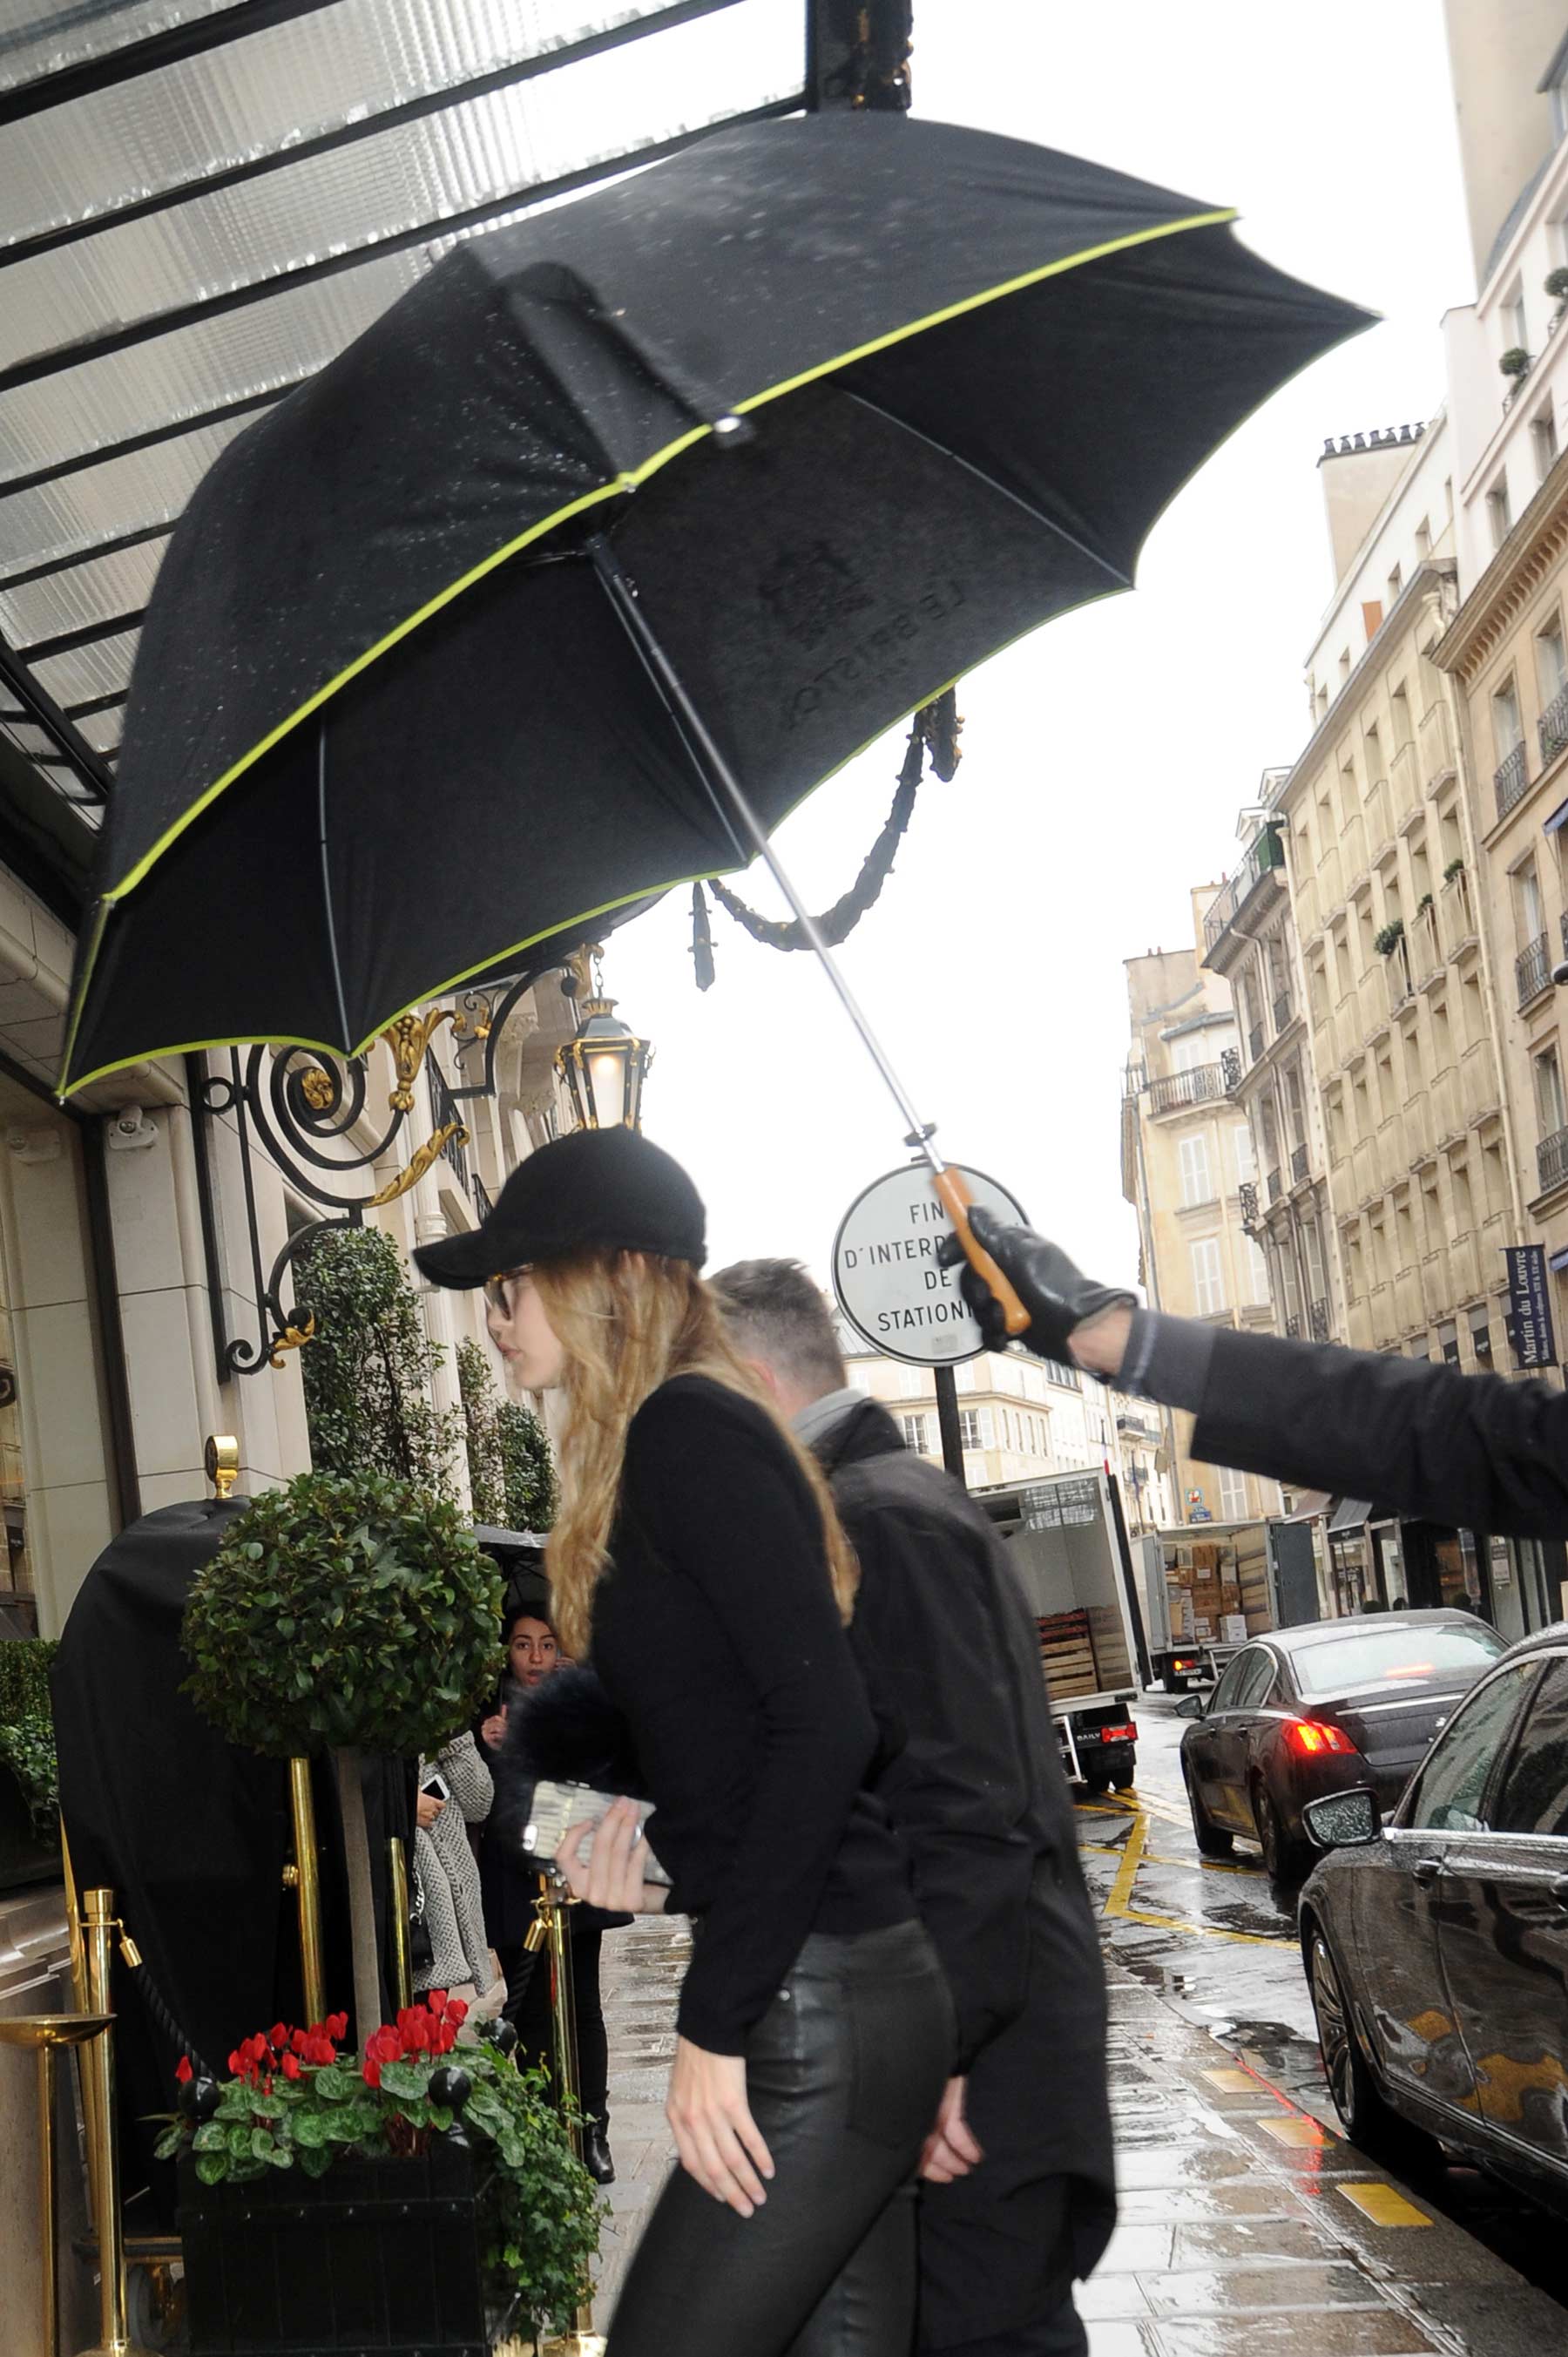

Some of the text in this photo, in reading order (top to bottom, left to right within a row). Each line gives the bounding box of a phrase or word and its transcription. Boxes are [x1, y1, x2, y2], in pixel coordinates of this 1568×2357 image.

[909, 1201, 945, 1223] FIN
[923, 1269, 952, 1290] DE
[1516, 1250, 1538, 1363] Martin du Louvre
[1077, 1732, 1101, 1742] DAILY
